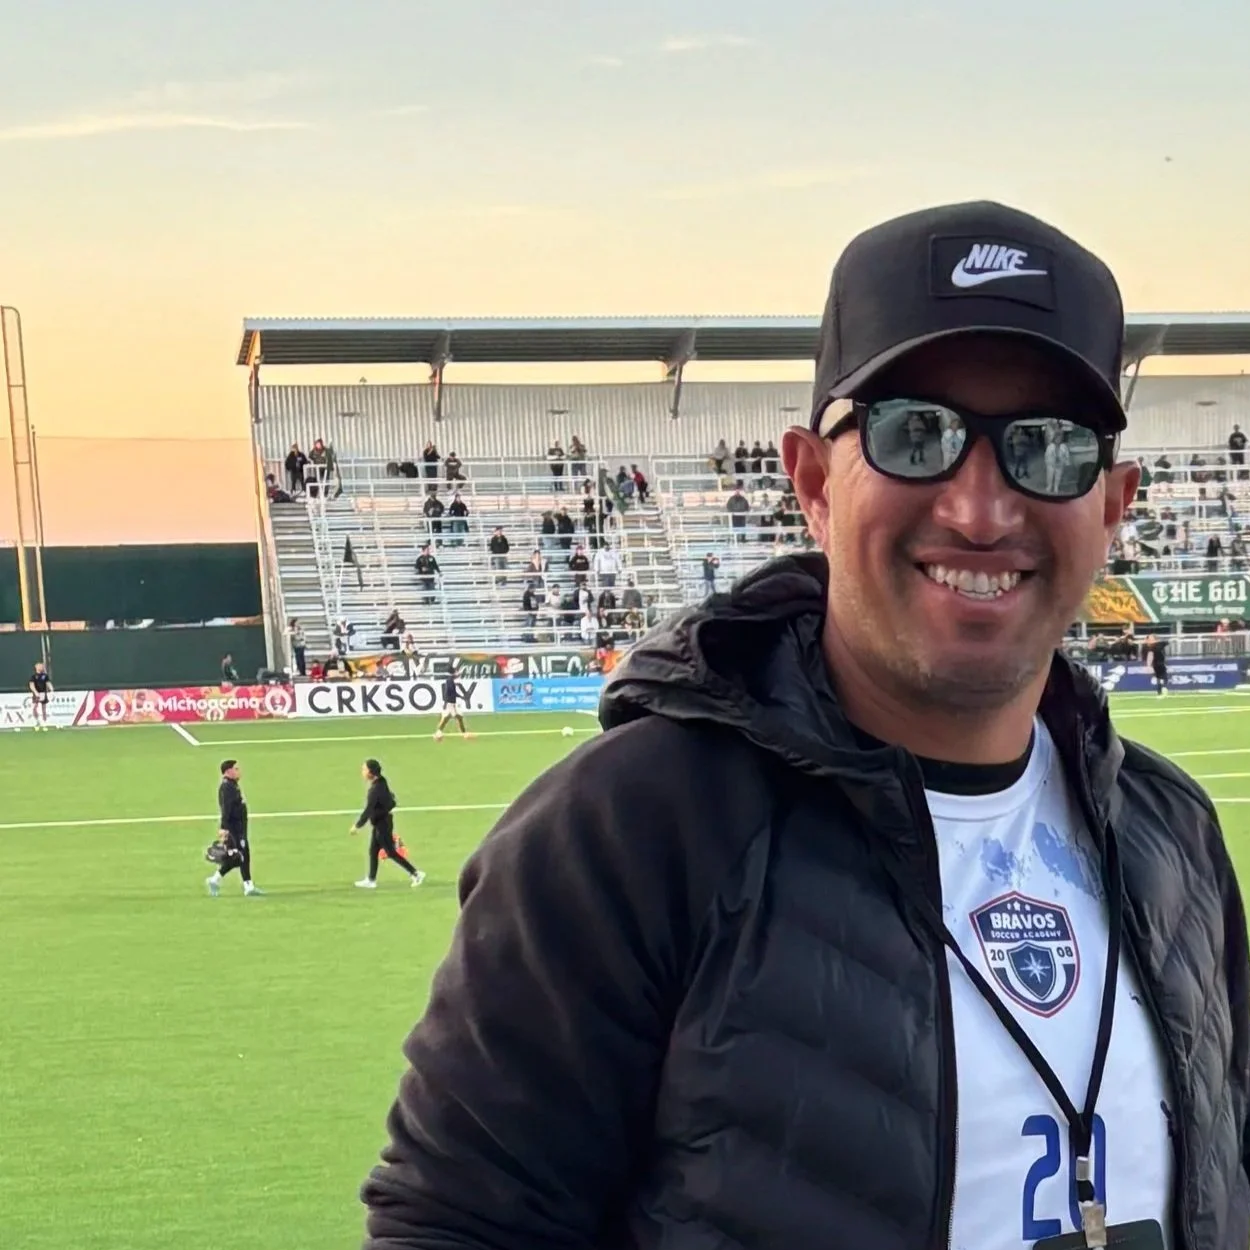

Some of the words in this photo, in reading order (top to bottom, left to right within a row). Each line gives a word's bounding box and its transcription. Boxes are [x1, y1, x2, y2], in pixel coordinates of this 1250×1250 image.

[964, 243, 1028, 271] NIKE
[1152, 580, 1203, 603] THE
[1208, 579, 1248, 602] 661
[131, 698, 158, 713] La
[158, 695, 260, 712] Michoacana
[989, 913, 1056, 930] BRAVOS
[991, 930, 1020, 939] SOCCER
[1023, 930, 1061, 939] ACADEMY
[990, 949, 1005, 961] 20
[1056, 946, 1074, 958] 08
[1022, 1113, 1107, 1241] 20
